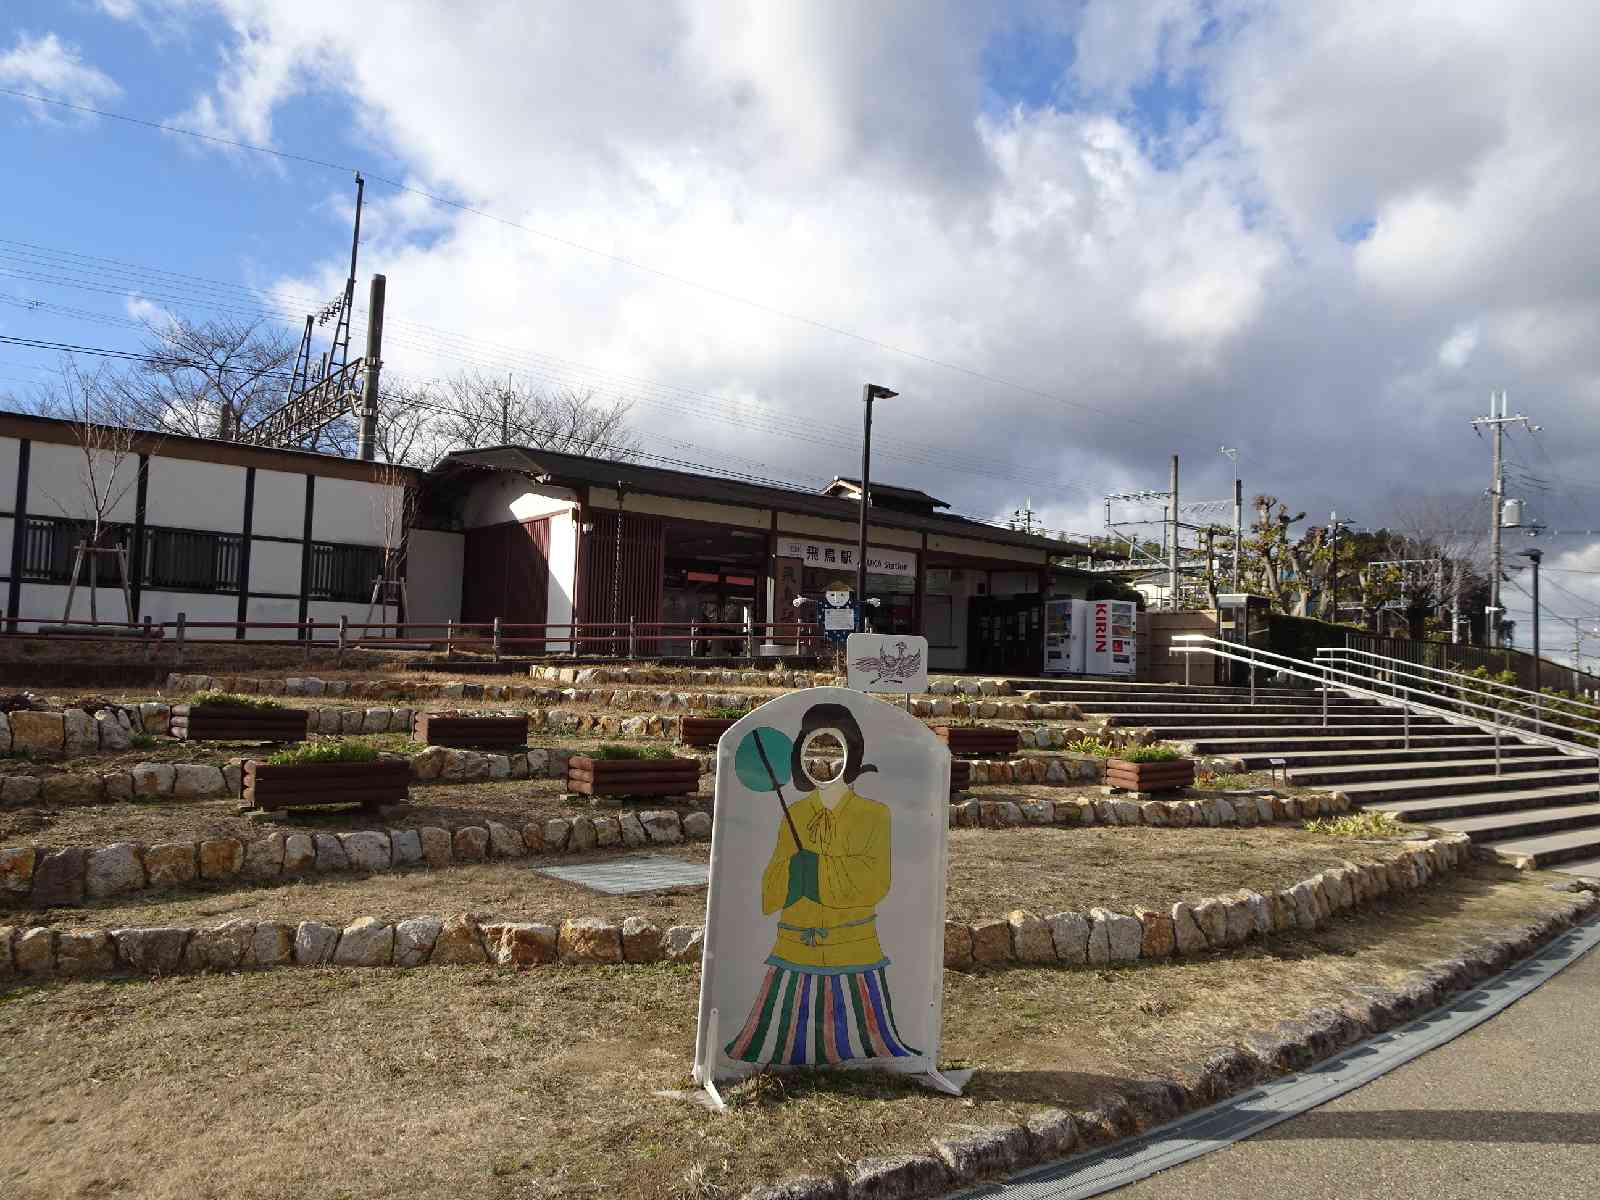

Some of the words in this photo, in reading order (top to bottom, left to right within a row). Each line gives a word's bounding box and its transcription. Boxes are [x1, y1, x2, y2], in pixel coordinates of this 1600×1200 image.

[806, 545, 852, 564] 飛鳥駅
[883, 559, 908, 571] Station
[1095, 603, 1107, 653] KIRIN
